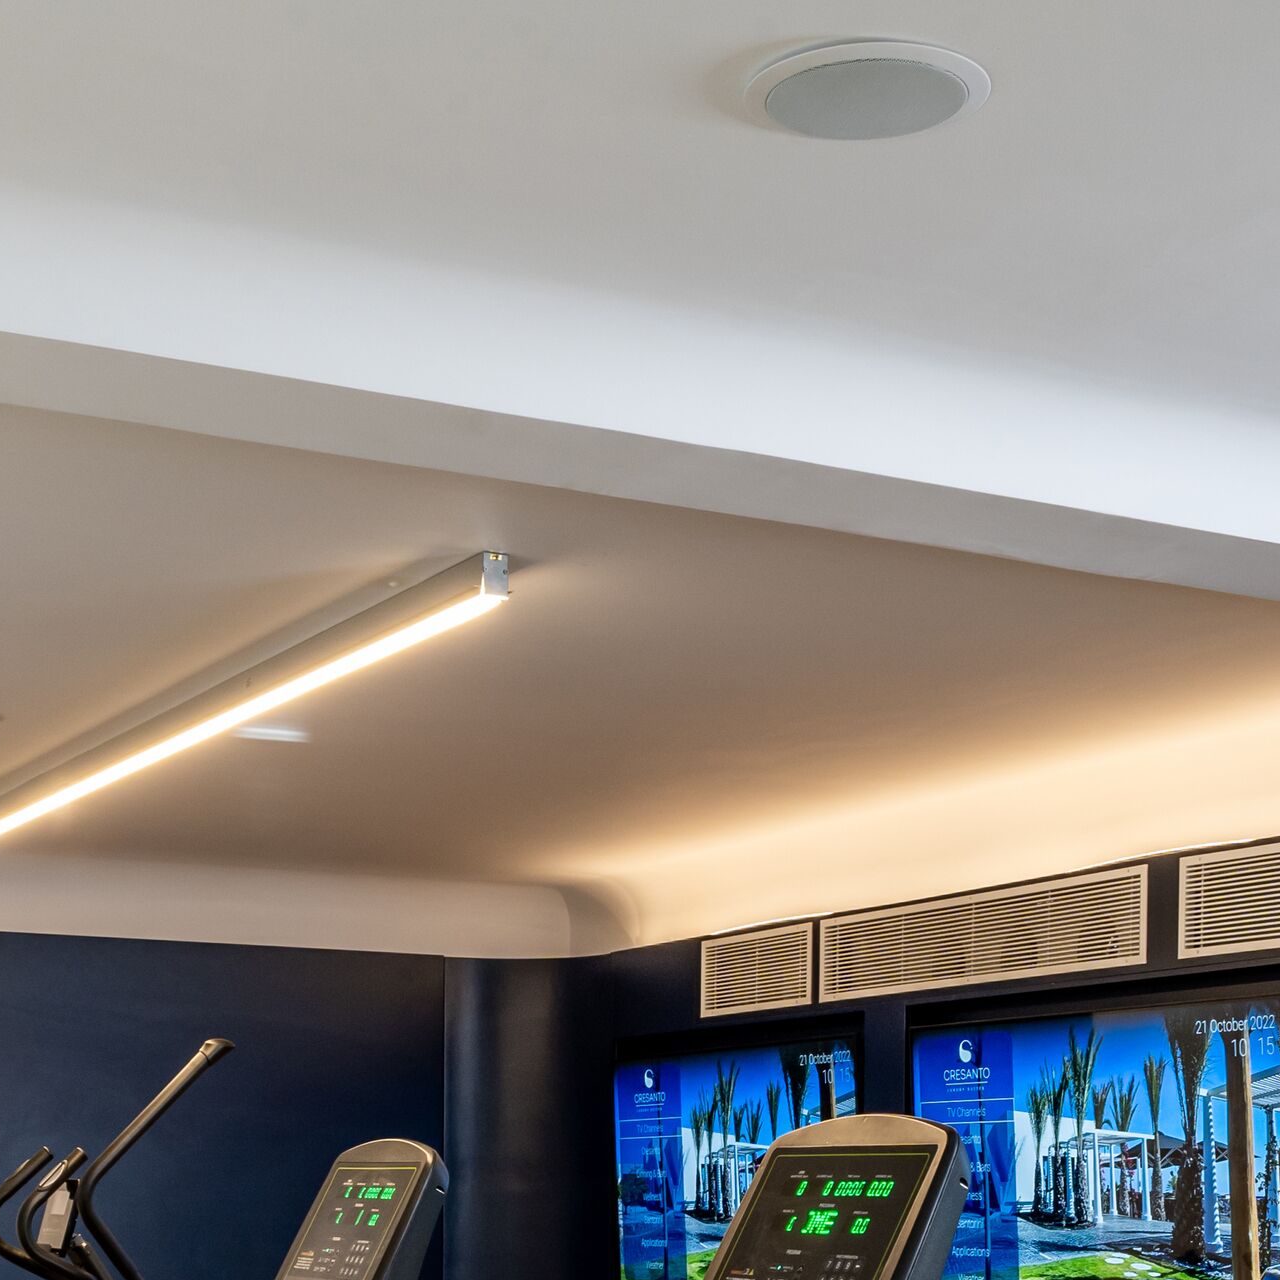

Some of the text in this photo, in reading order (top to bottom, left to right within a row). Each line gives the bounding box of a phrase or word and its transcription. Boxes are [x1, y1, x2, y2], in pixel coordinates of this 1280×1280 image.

[1195, 1014, 1275, 1035] 21 October 2022
[1231, 1036, 1275, 1057] 10 15
[808, 1052, 834, 1065] October
[943, 1067, 991, 1081] CRESANTO
[946, 1106, 986, 1118] TV Channels
[951, 1246, 991, 1258] Applications
